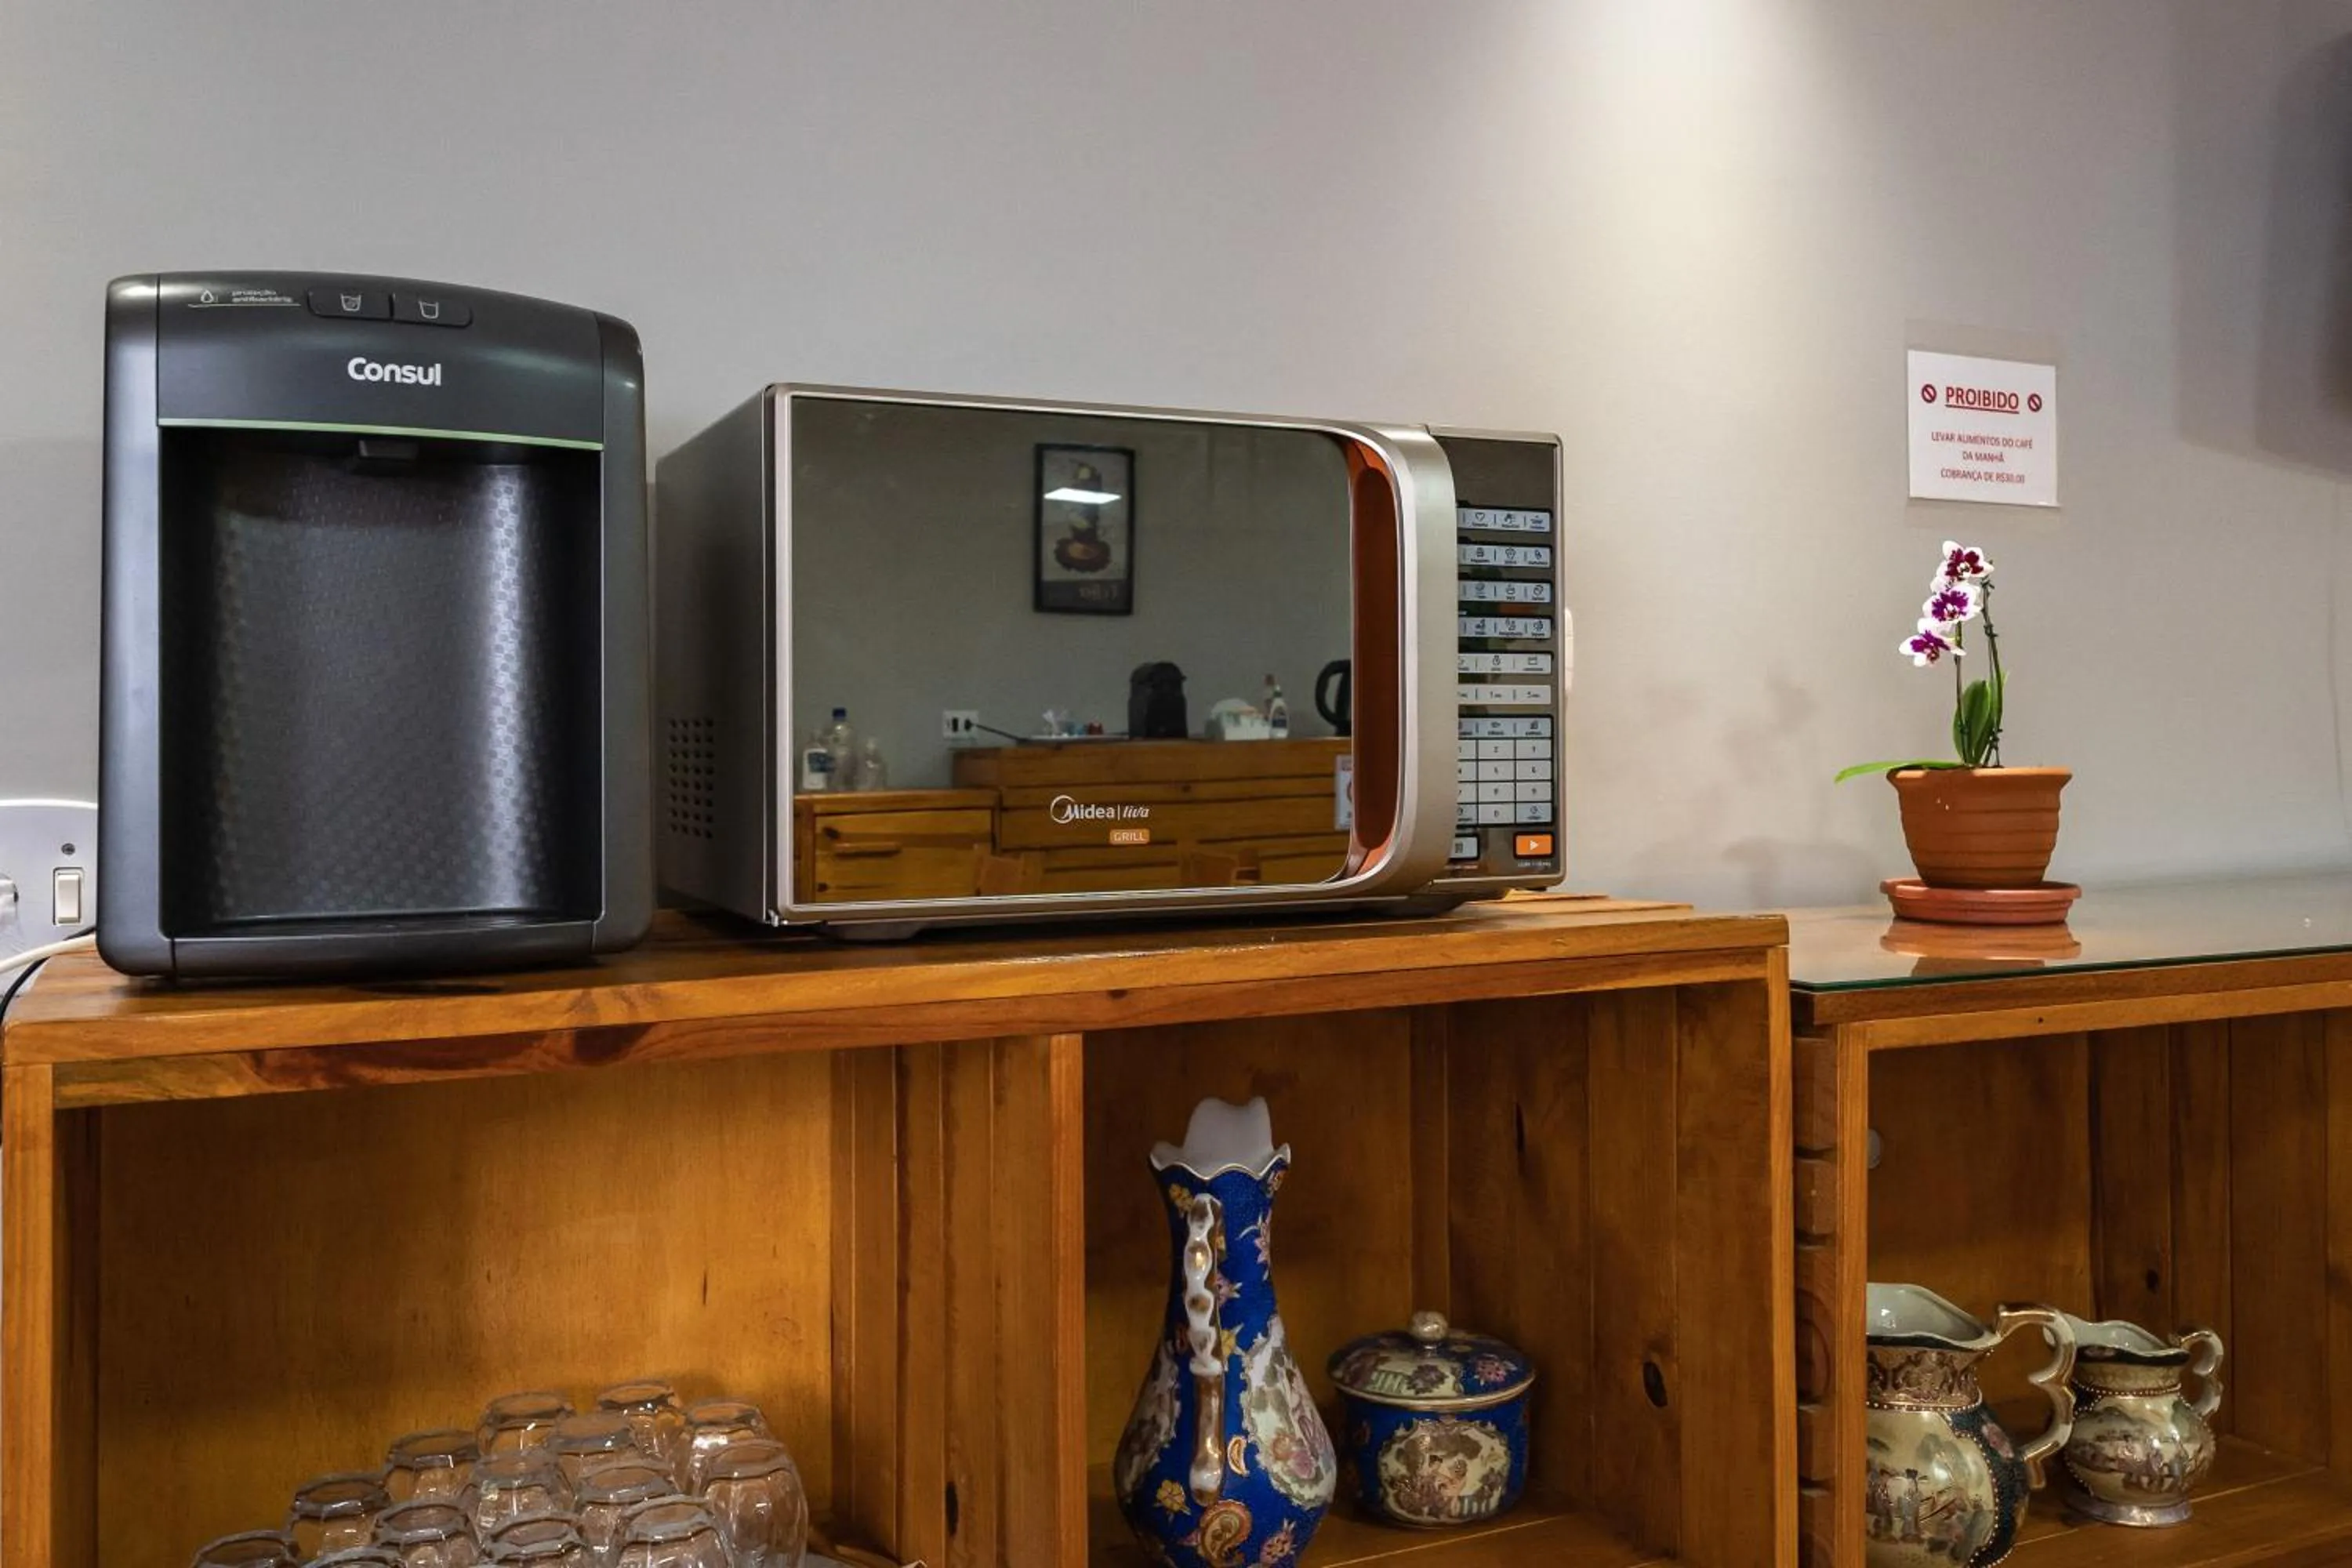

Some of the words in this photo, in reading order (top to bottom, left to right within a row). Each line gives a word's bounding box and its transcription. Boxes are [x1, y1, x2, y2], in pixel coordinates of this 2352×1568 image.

[347, 357, 441, 386] Consul
[1945, 387, 2020, 410] PROIBIDO
[1931, 432, 1955, 443] LEVAR
[1957, 434, 2000, 446] ALIMENTOS
[2002, 438, 2013, 448] DO
[1962, 451, 1973, 461] DA
[1940, 468, 1983, 481] COBRANÇA
[1984, 472, 1994, 481] DE
[1123, 804, 1150, 818] liva
[1113, 831, 1146, 842] GRILL
